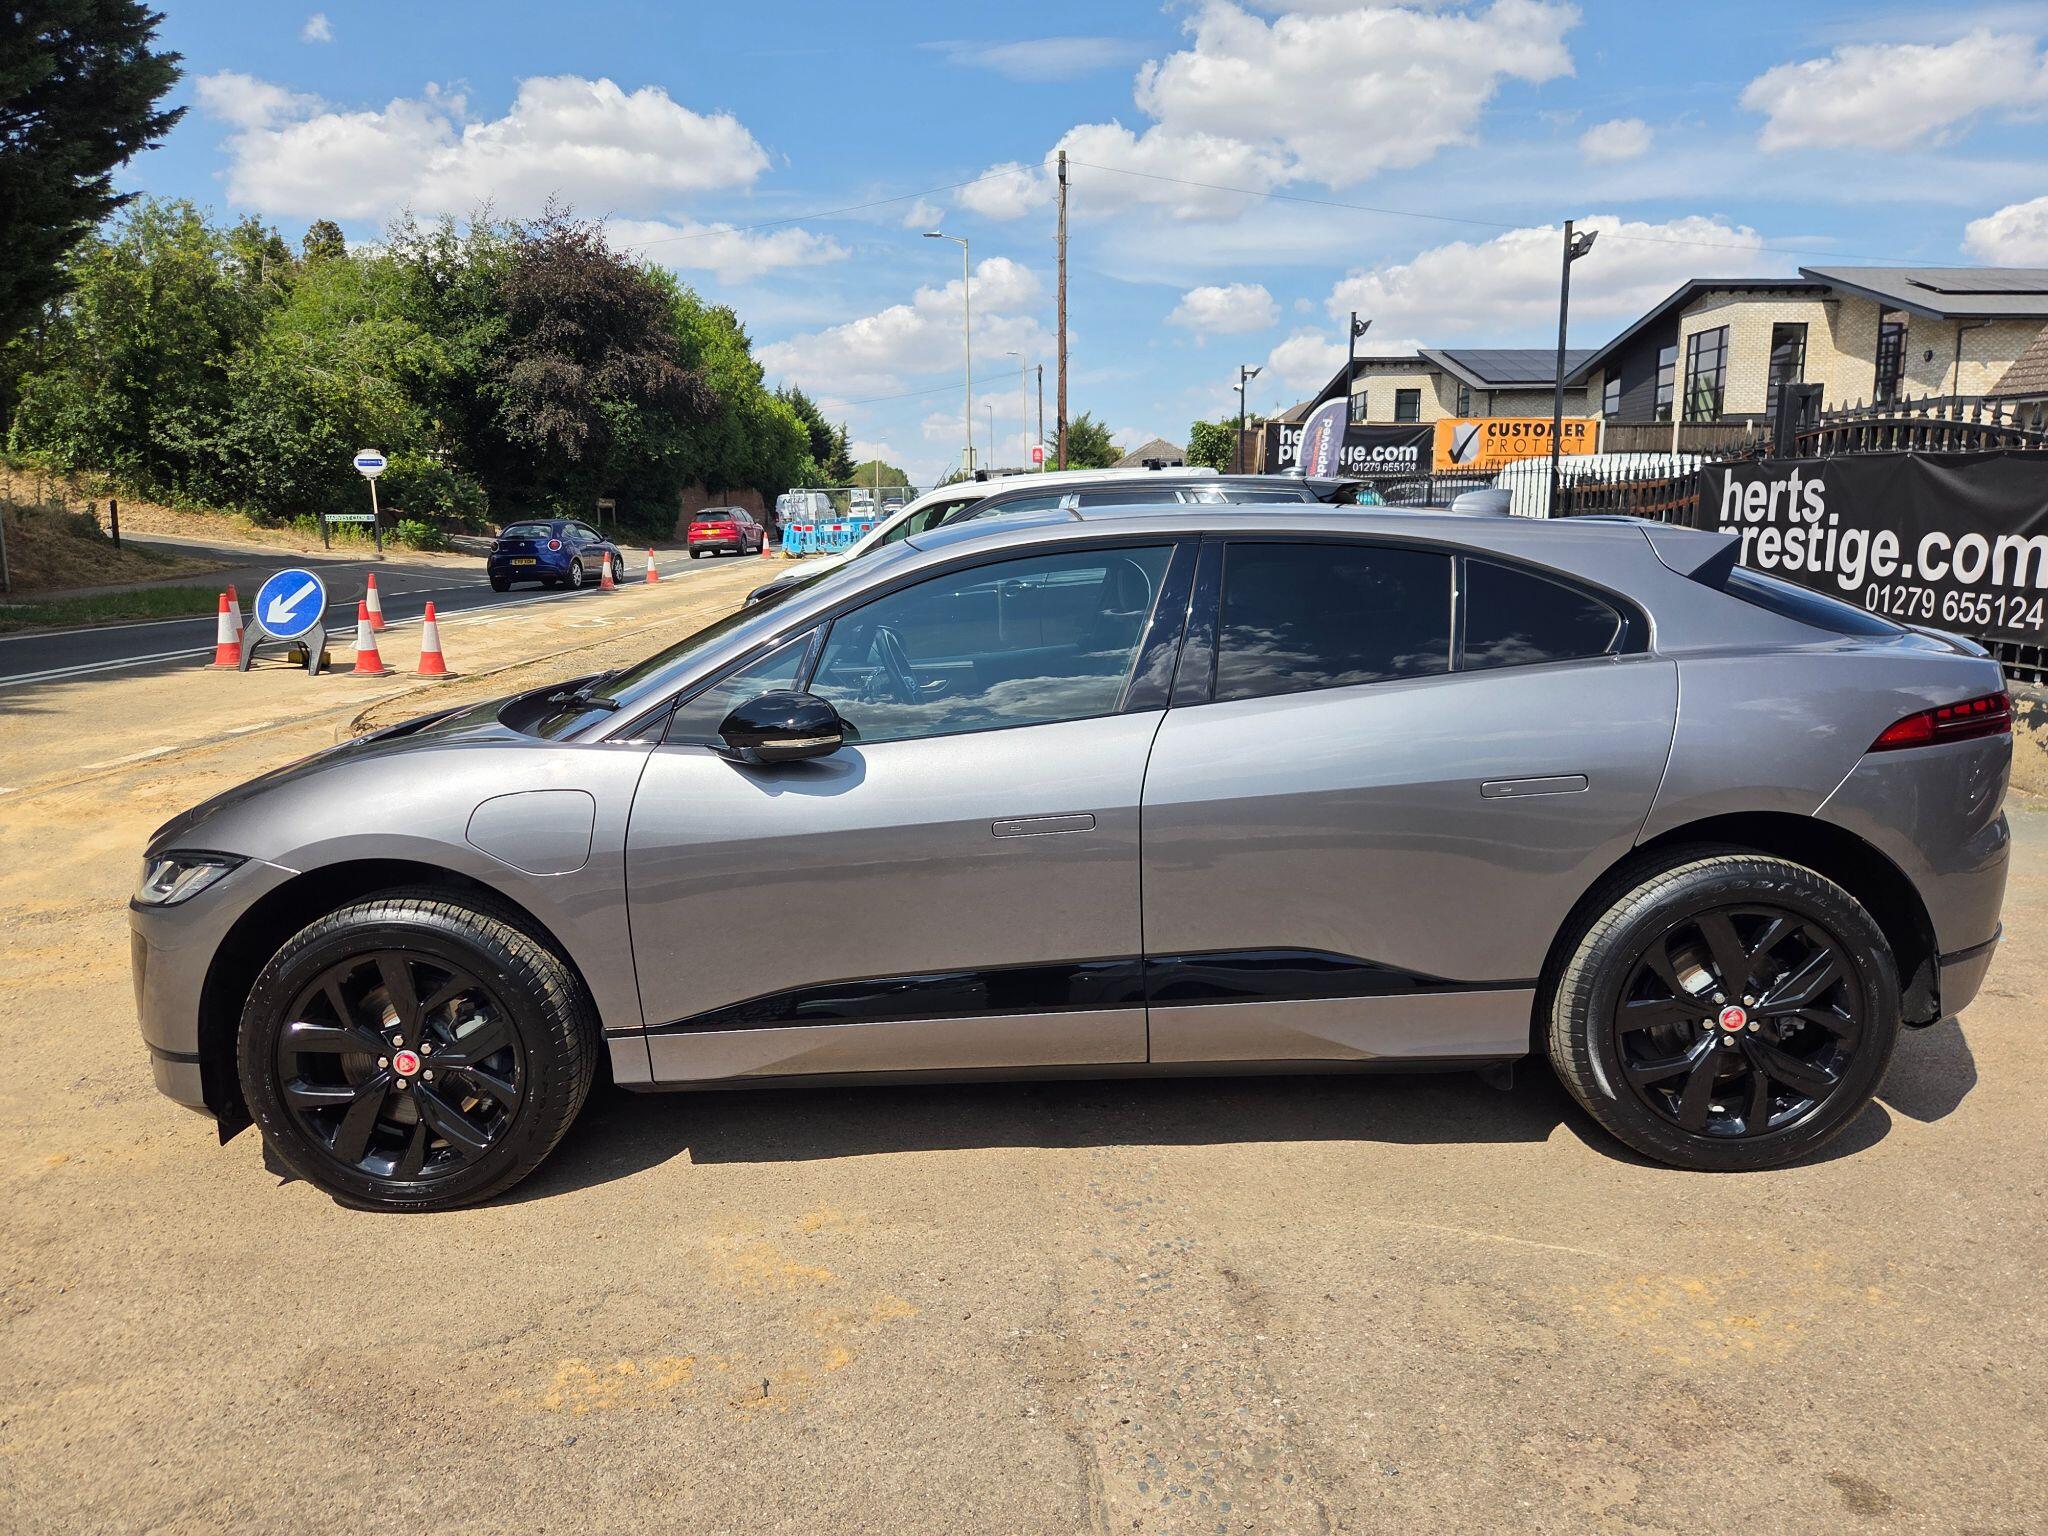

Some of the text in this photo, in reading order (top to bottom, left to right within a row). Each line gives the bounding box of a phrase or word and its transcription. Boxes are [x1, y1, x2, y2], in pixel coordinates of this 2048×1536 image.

[1352, 462, 1380, 472] 01279
[1719, 467, 1839, 526] herts.
[1718, 522, 2048, 591] restige.com
[1865, 582, 2044, 631] 01279 655124
